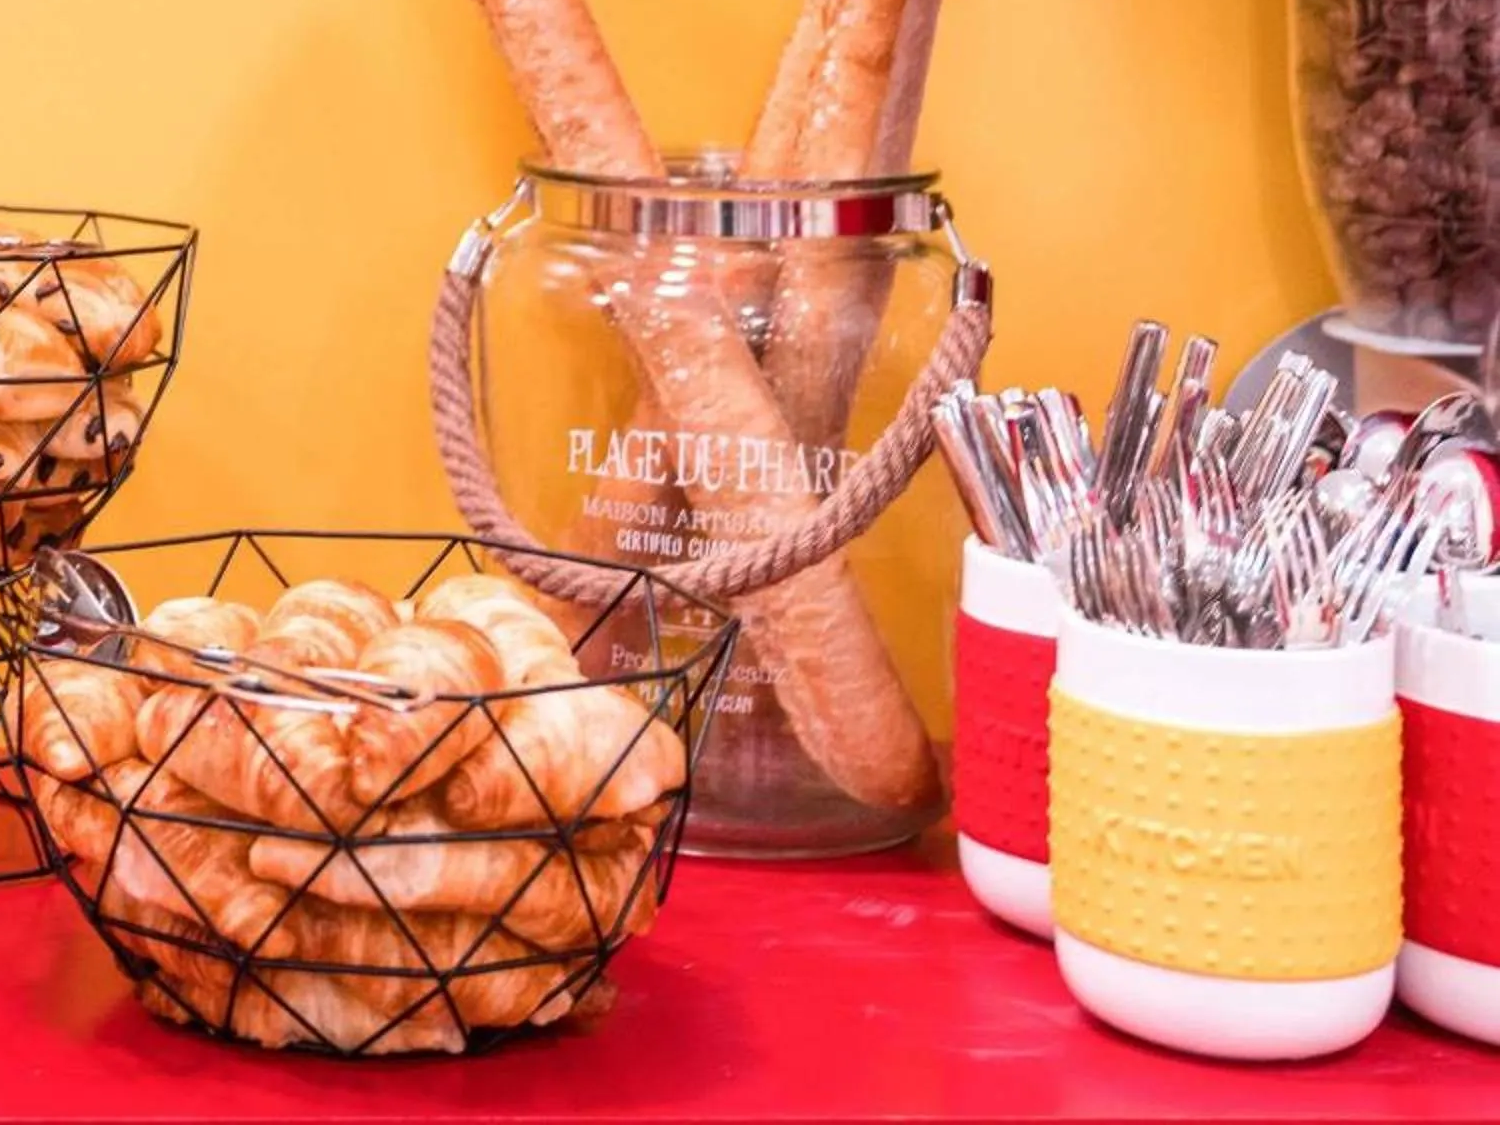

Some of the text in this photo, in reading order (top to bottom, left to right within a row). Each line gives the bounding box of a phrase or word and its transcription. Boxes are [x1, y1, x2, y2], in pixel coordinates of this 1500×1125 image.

[567, 428, 668, 487] PLAGE
[673, 432, 730, 493] DU
[582, 494, 667, 527] MAISON
[1093, 805, 1303, 882] KITCHEN
